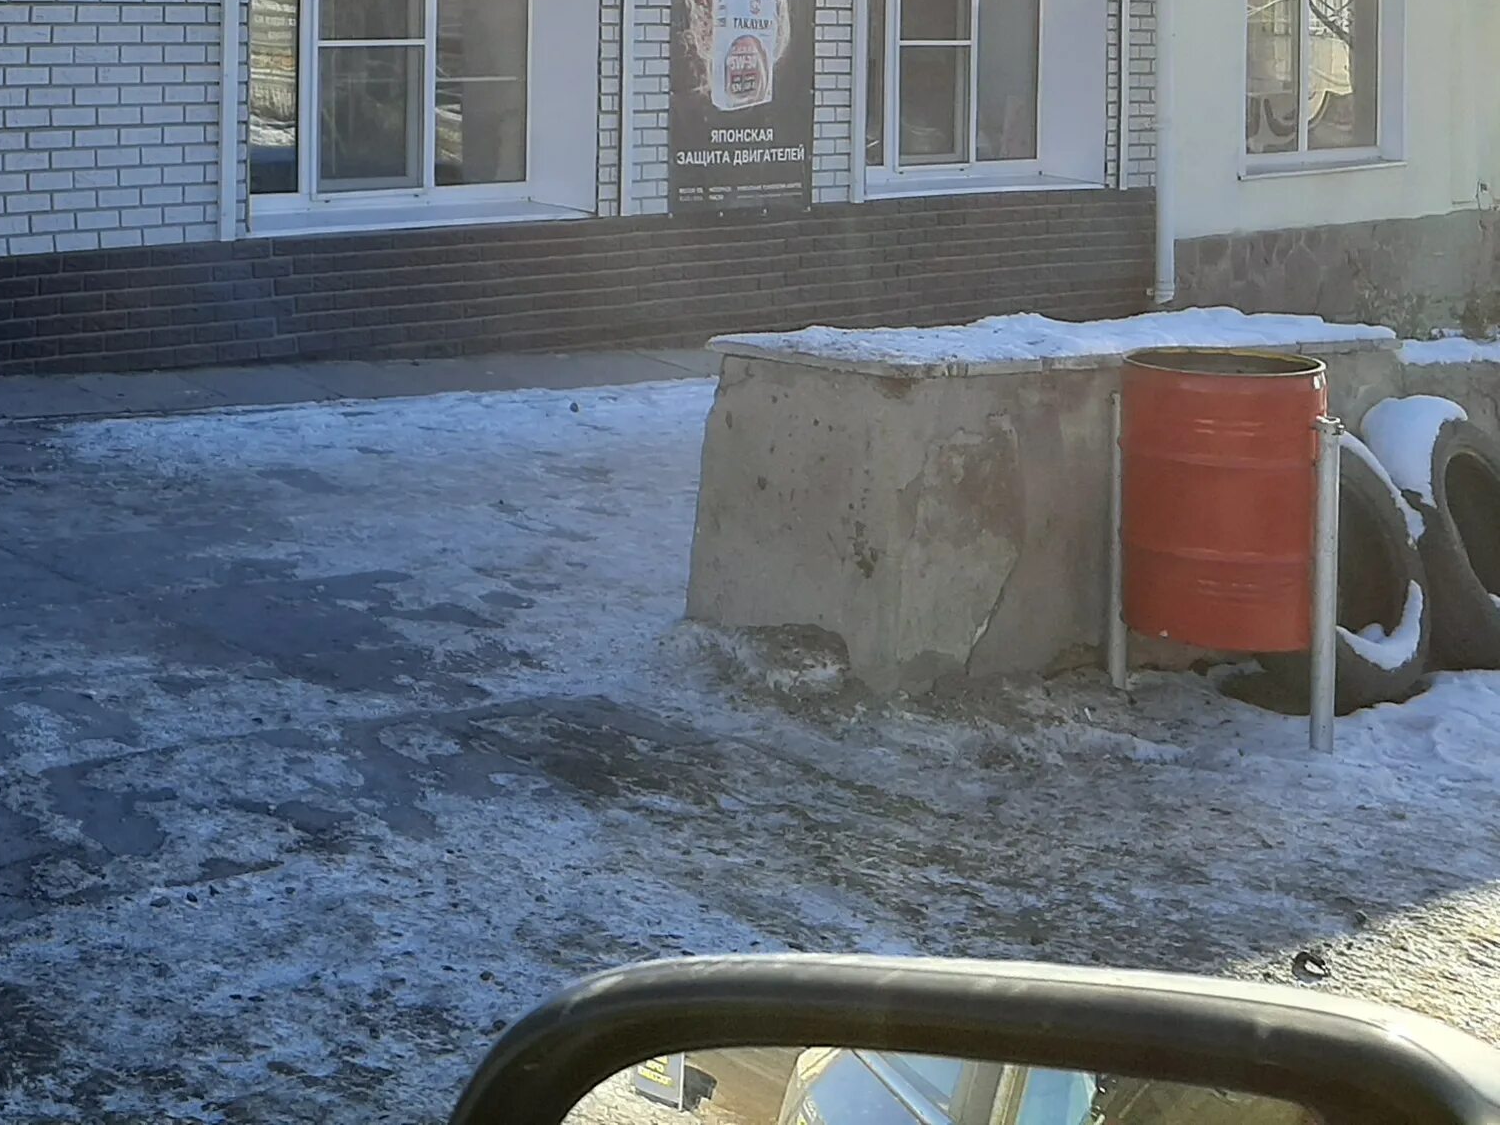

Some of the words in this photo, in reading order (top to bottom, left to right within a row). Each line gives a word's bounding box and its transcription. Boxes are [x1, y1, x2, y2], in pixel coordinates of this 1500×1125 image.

[710, 128, 773, 144] ЯПОНСКАЯ
[676, 150, 731, 167] ЗАЩИТА
[733, 143, 805, 166] ДВИГАТЕЛЕЙ
